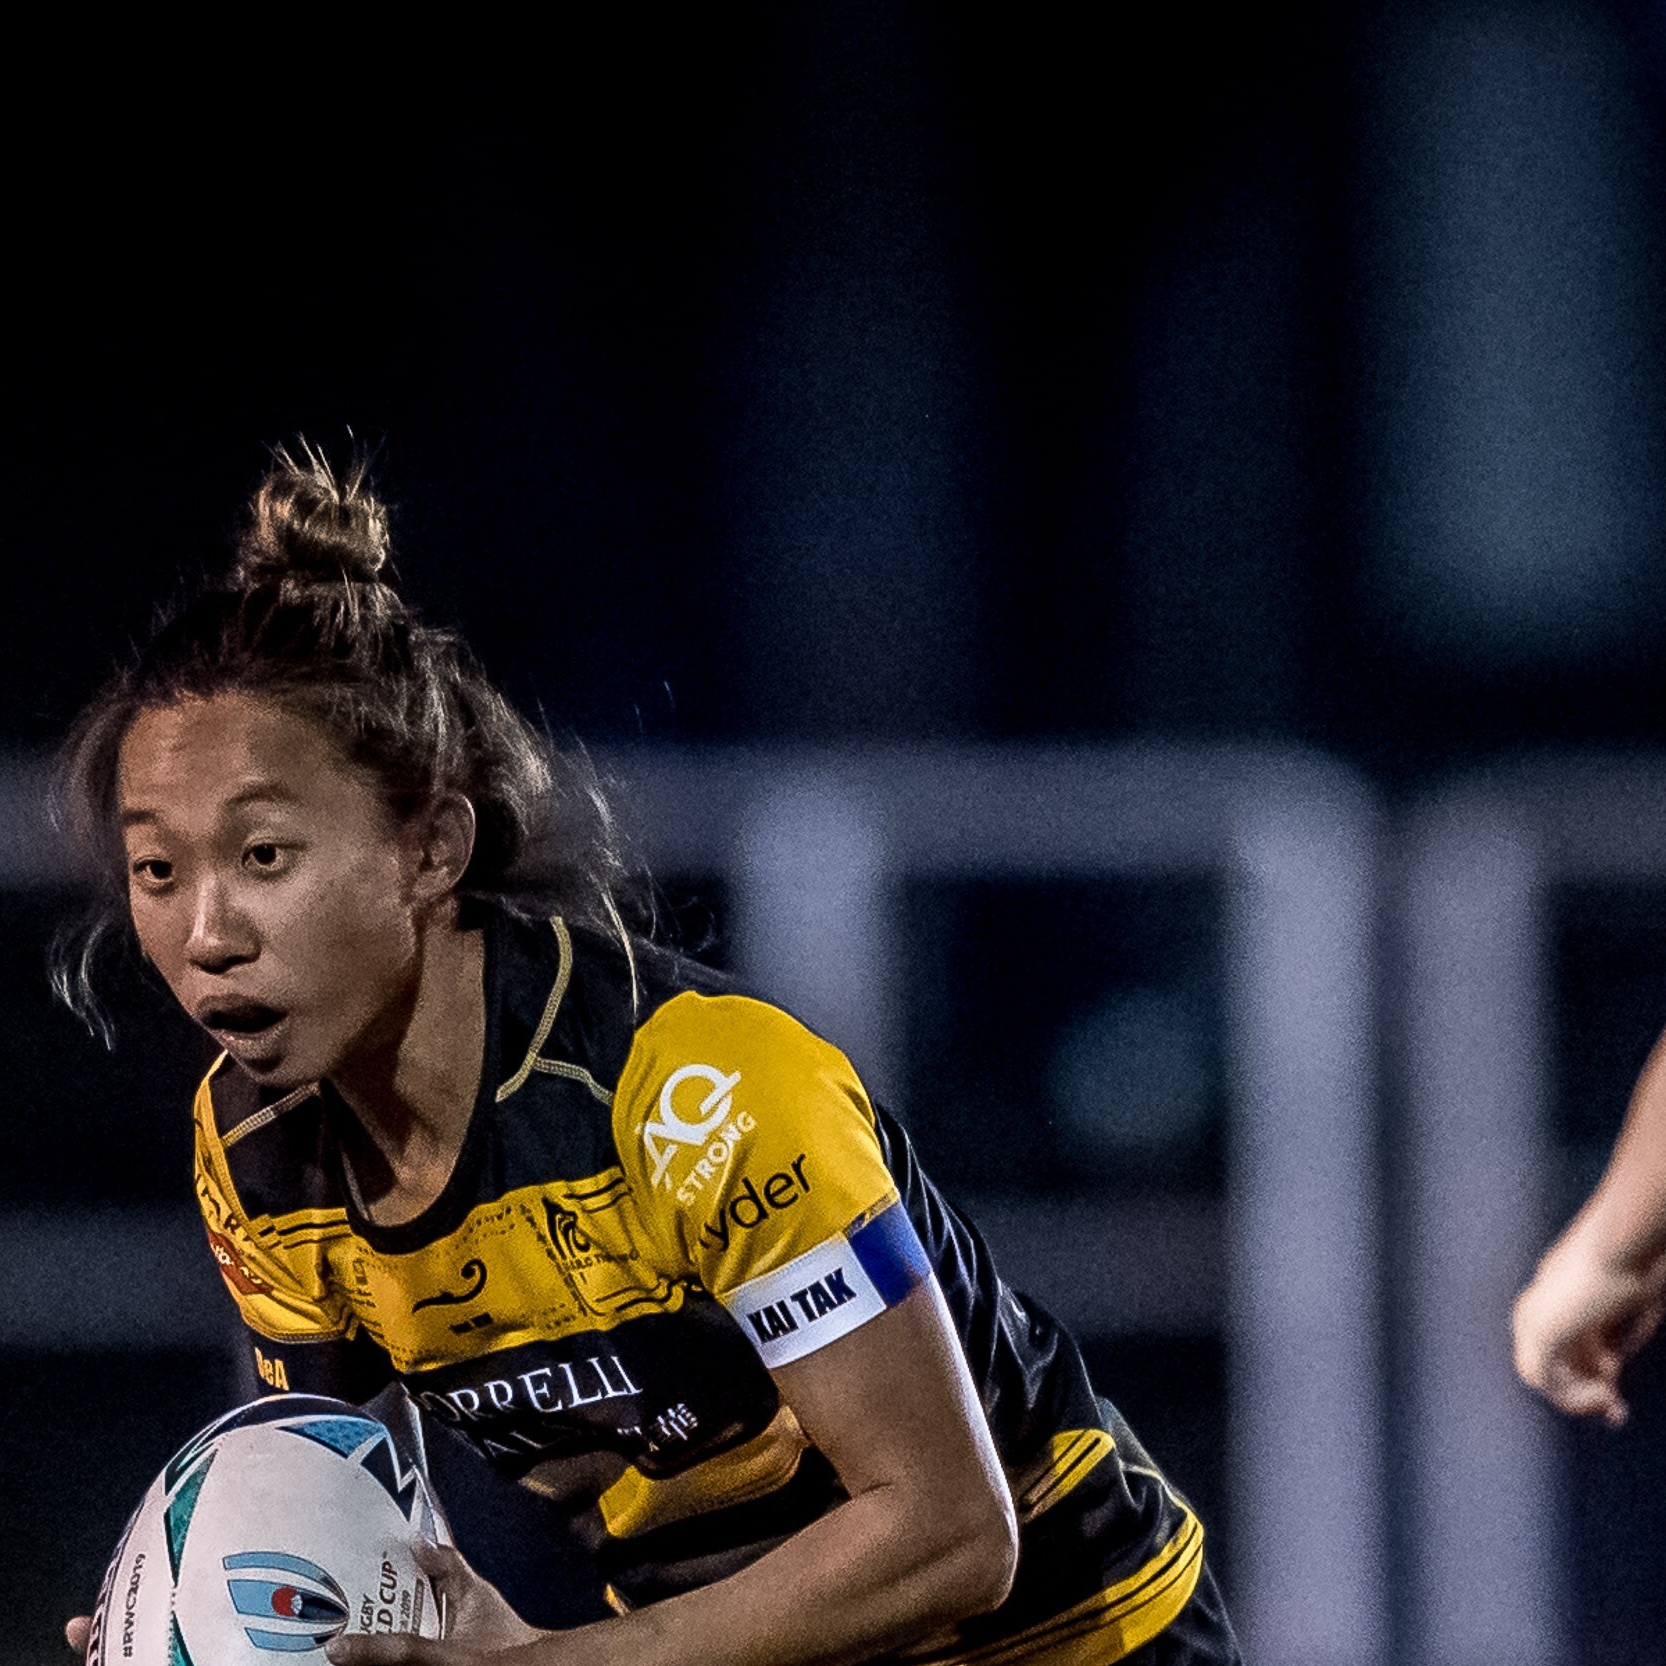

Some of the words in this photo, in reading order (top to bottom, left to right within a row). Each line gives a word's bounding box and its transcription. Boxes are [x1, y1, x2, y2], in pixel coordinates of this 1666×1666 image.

[676, 1110, 757, 1206] STRONG
[699, 1153, 808, 1252] yder
[747, 1299, 799, 1345] KAI
[790, 1266, 857, 1323] TAK
[122, 1552, 147, 1658] #RWC2019
